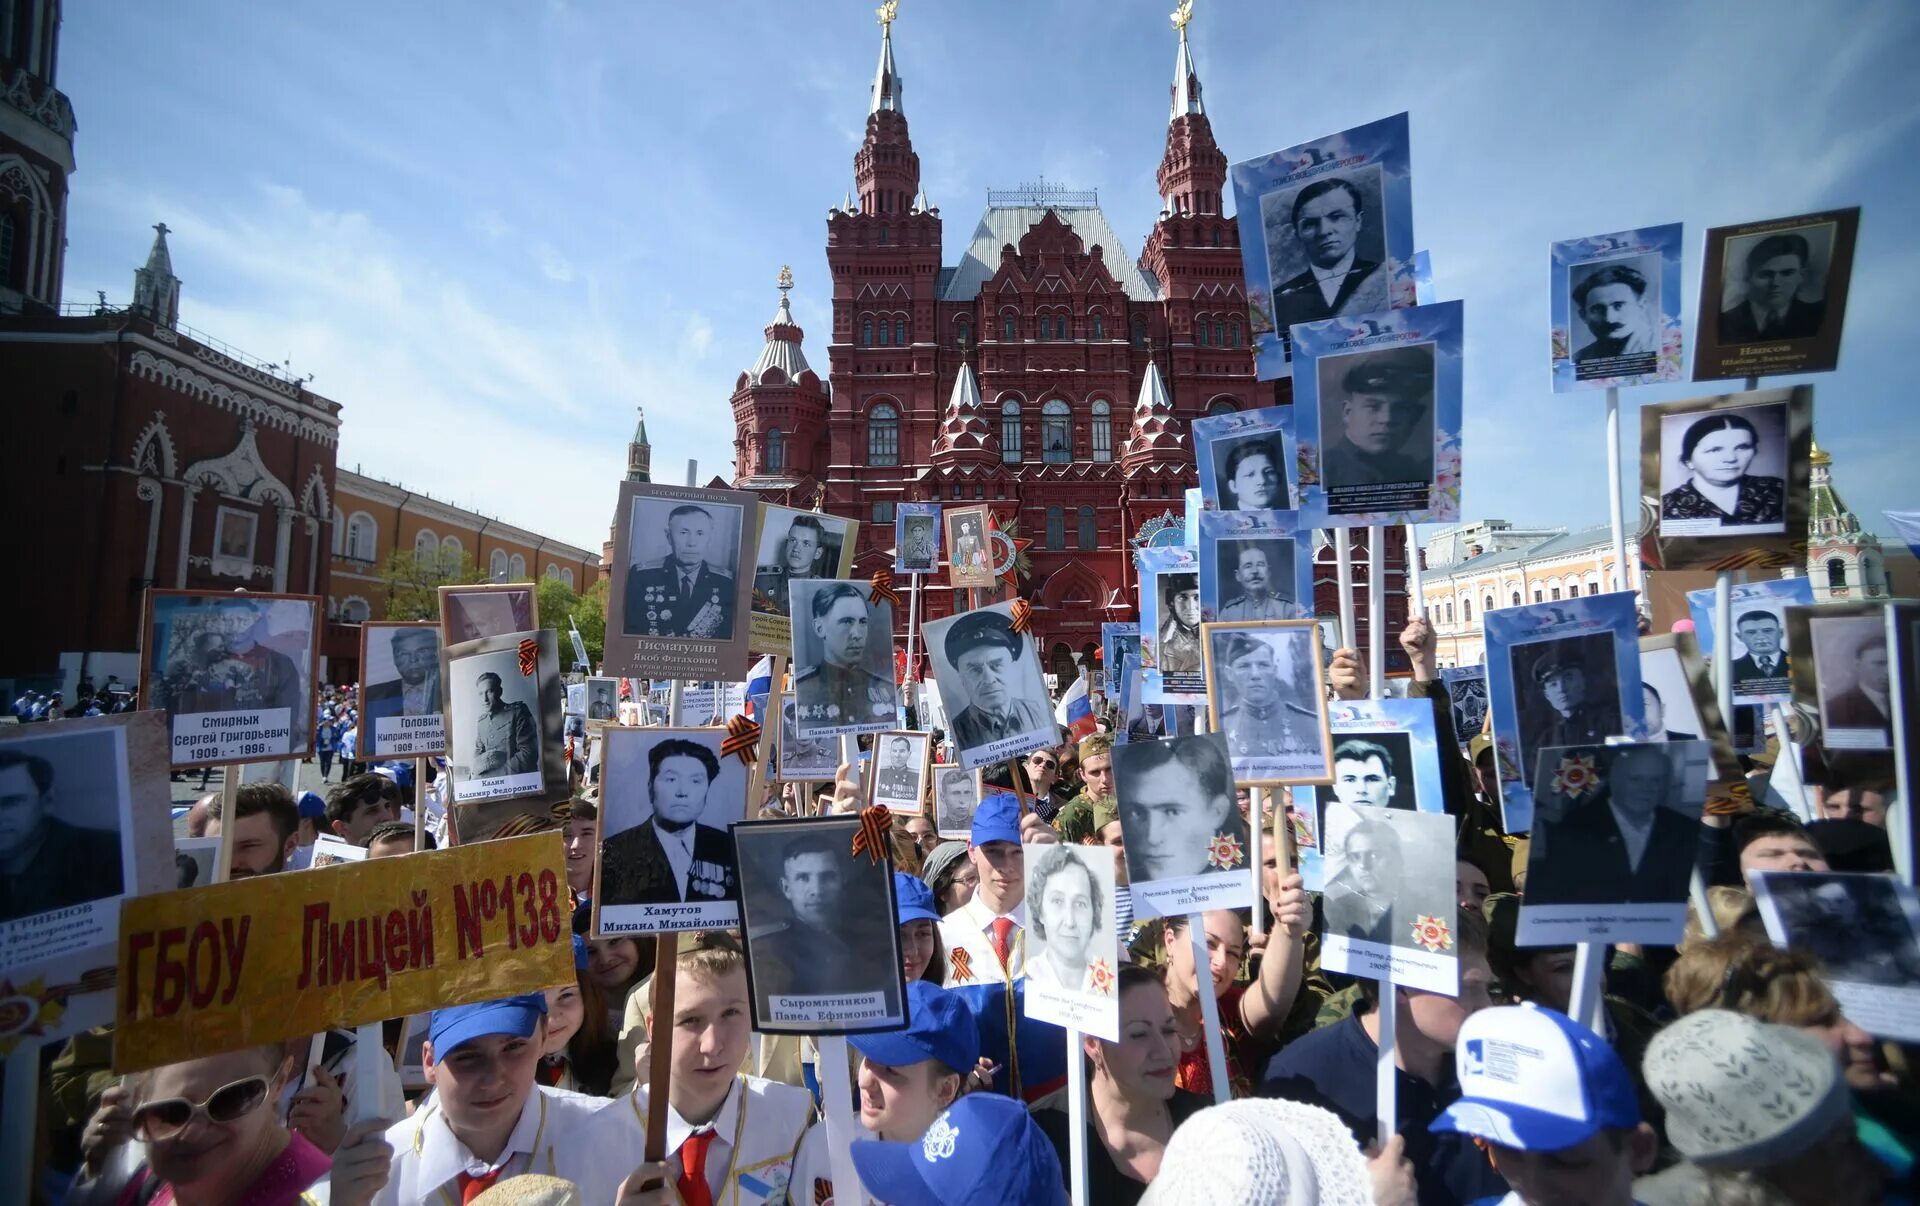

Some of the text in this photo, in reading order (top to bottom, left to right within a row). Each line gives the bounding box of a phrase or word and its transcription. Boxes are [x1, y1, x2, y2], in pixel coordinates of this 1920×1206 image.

[638, 640, 717, 654] Гисматулин
[633, 653, 660, 661] Якоб
[202, 715, 259, 729] Смирных
[401, 717, 440, 728] Головин
[174, 728, 289, 746] Сергей Григорьевич
[377, 732, 413, 742] Киприян
[835, 726, 857, 735] Борис
[190, 747, 219, 759] 1909
[393, 743, 413, 752] 1909
[973, 740, 1050, 765] Федор Ефремович
[458, 784, 538, 800] Владимир Федорович
[643, 906, 702, 917] Хамутов
[604, 918, 739, 932] Михаил Михайлович
[125, 868, 562, 1021] ГБОУ Лицей №138
[780, 996, 876, 1009] Сыромятников
[775, 1009, 885, 1022] Павел Ефимович
